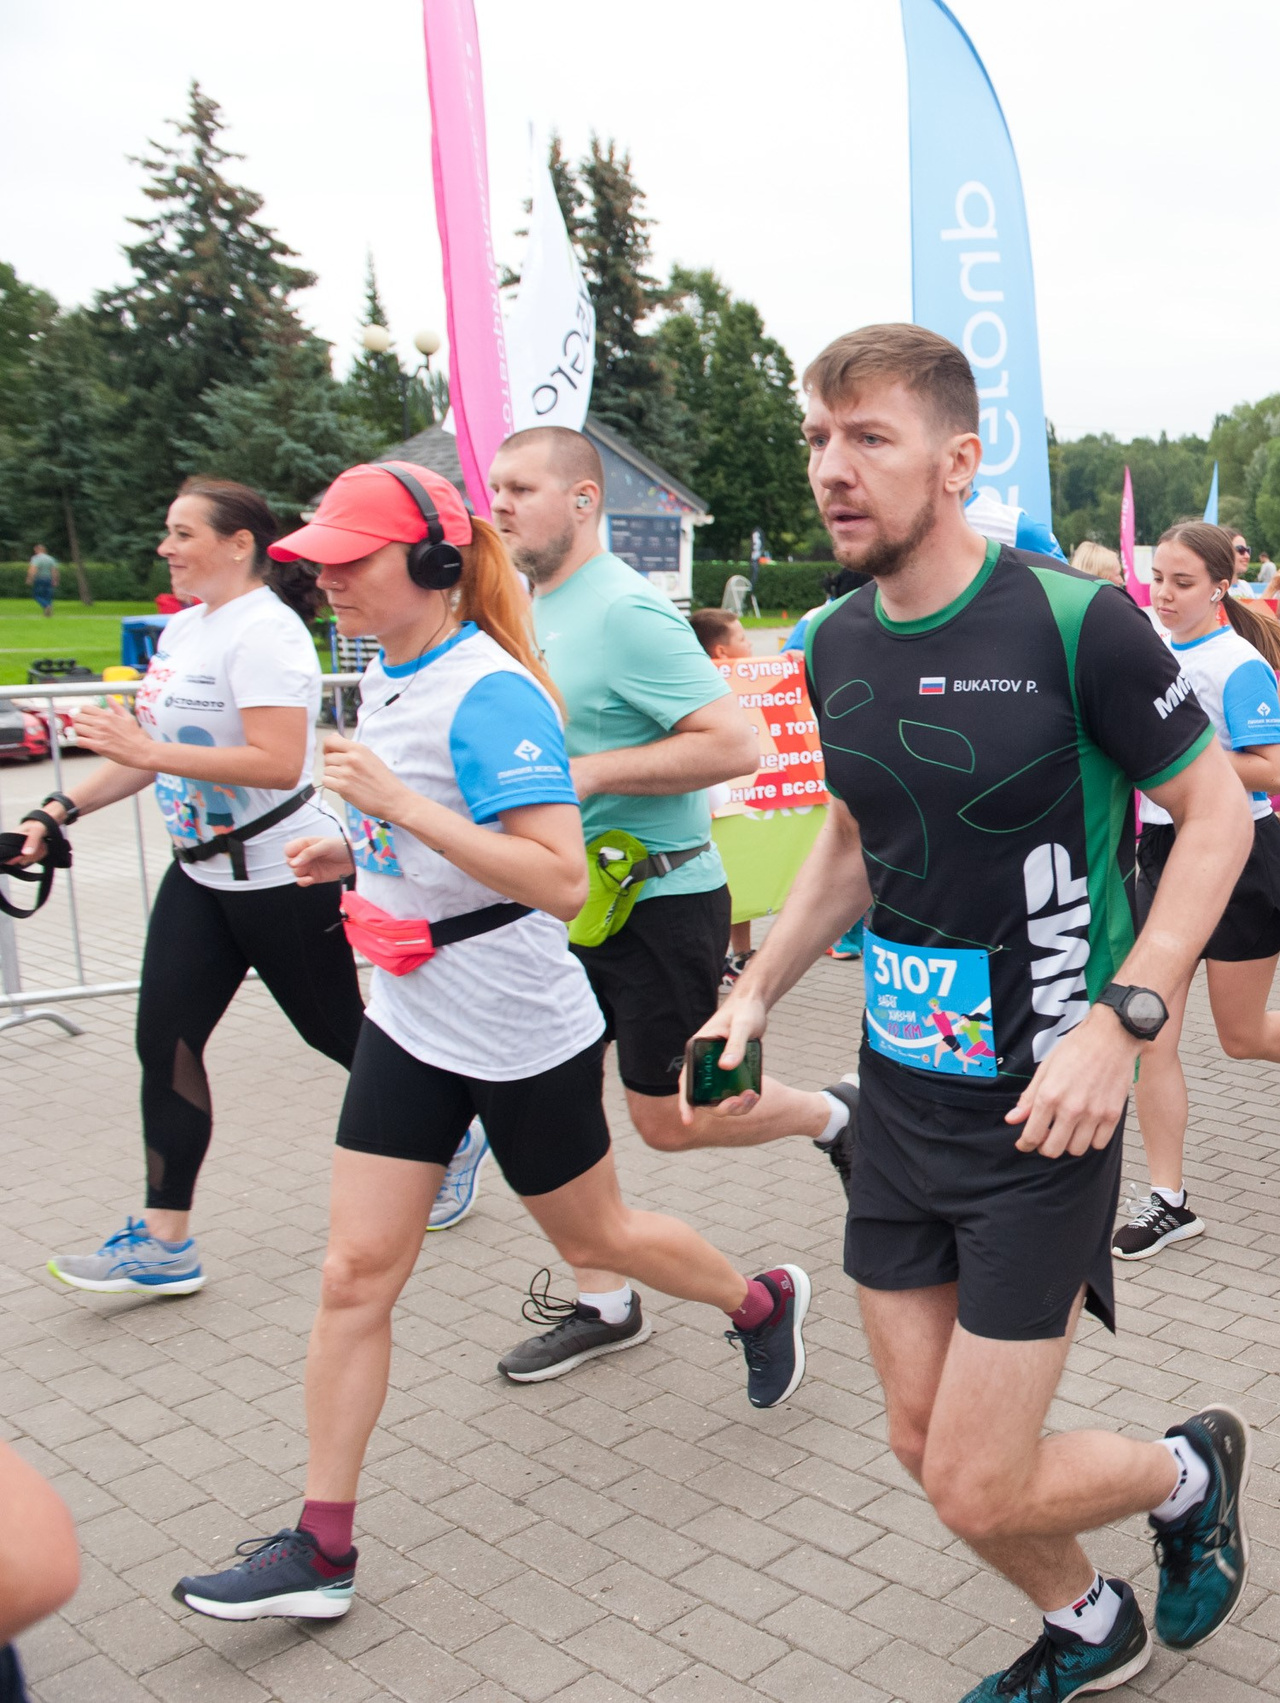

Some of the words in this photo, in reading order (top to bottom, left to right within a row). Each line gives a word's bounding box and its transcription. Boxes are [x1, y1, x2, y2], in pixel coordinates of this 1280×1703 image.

[737, 661, 800, 681] супер!
[953, 679, 1022, 693] BUKATOV
[1026, 680, 1039, 693] P.
[738, 687, 802, 709] класс!
[770, 723, 782, 737] в
[785, 720, 816, 736] тот
[730, 783, 777, 803] ните
[782, 779, 829, 796] всех
[872, 944, 957, 997] 3107
[887, 1023, 899, 1038] 10
